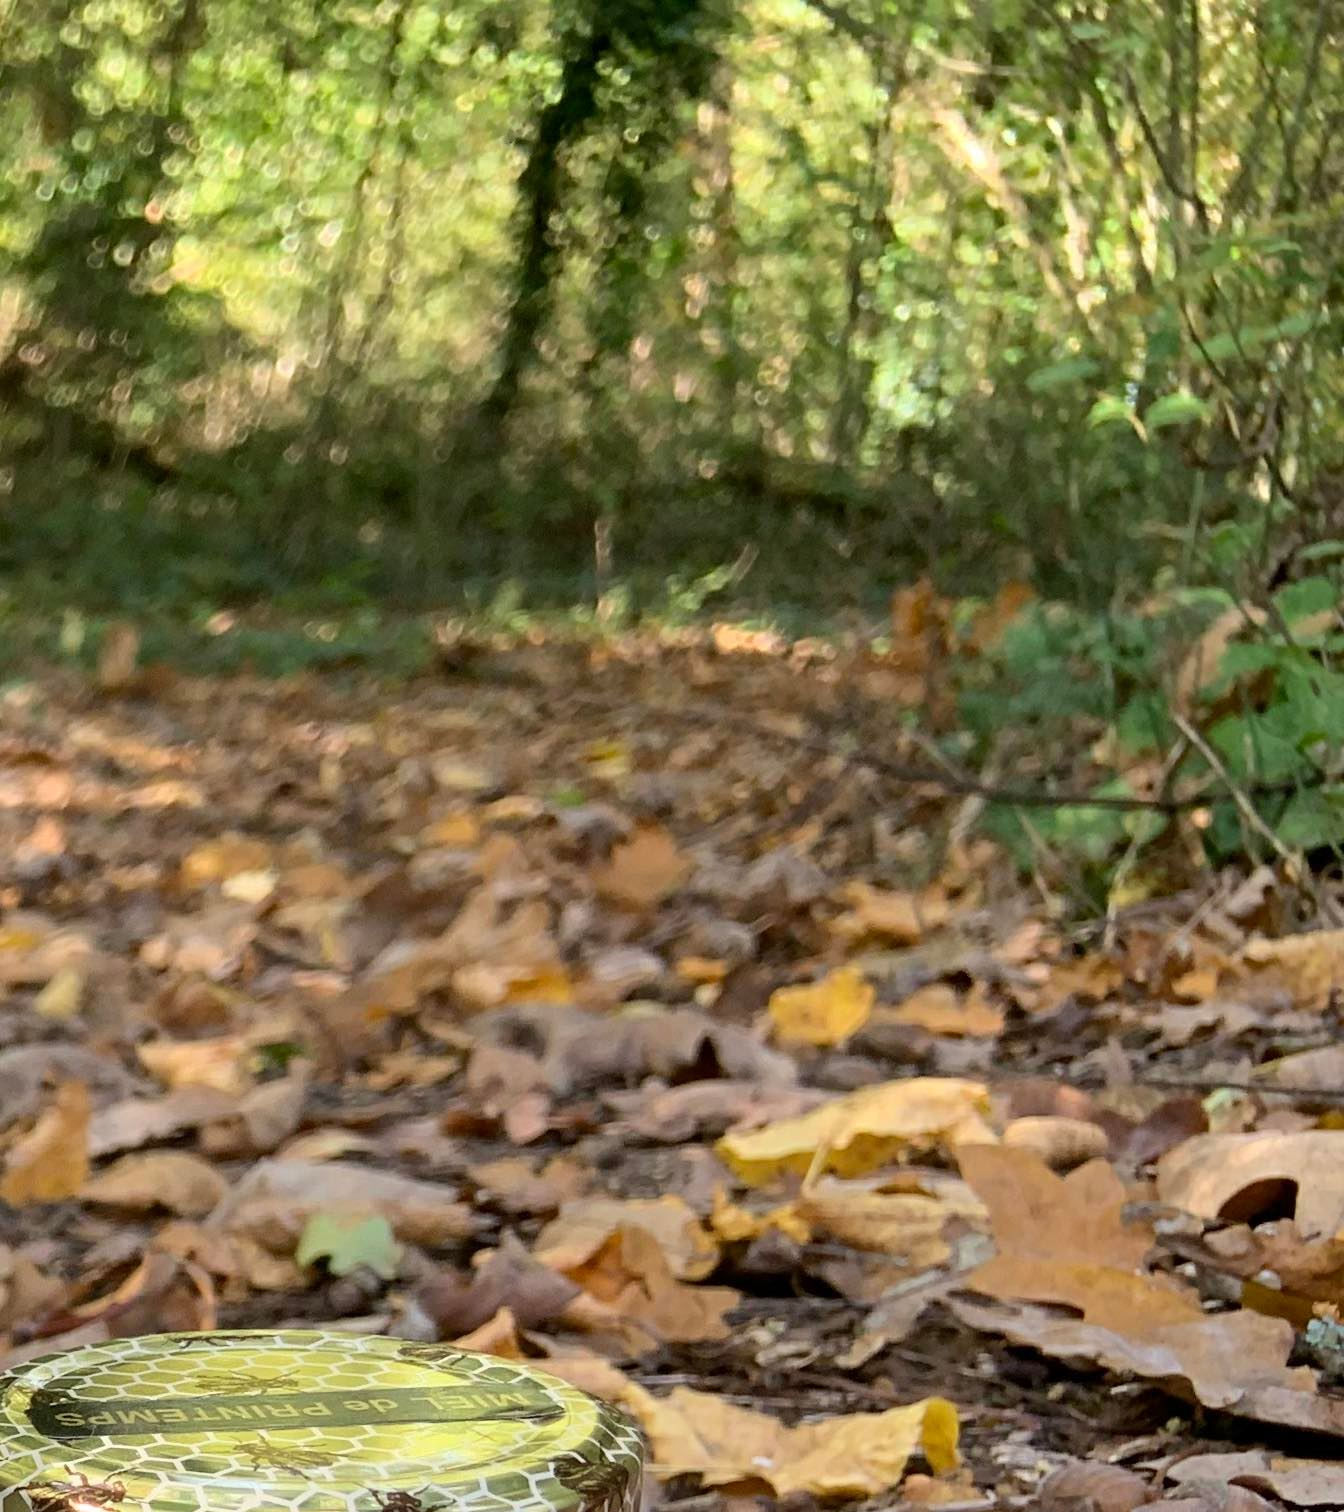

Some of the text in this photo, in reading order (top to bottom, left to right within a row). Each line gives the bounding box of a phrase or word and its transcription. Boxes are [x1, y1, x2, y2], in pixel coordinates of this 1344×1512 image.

[55, 1392, 532, 1429] MIEL de PRINTEMPS
